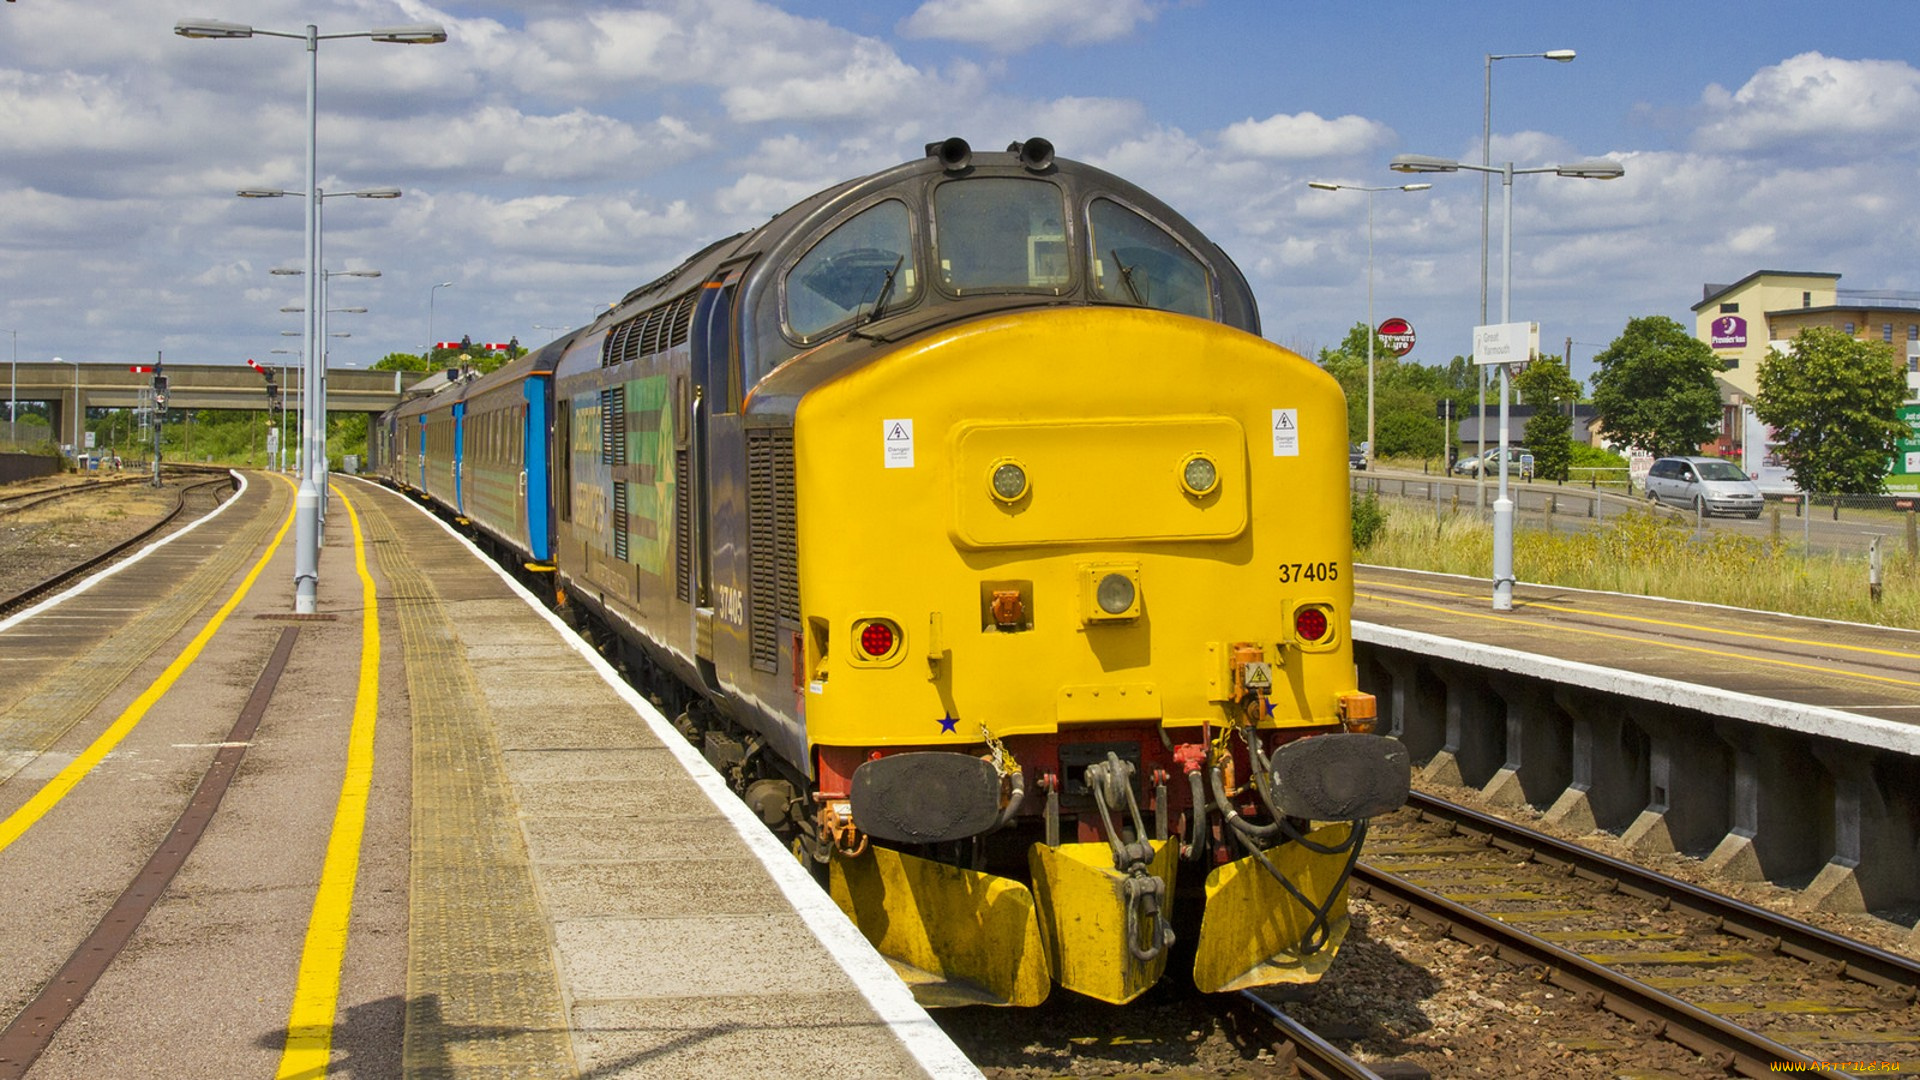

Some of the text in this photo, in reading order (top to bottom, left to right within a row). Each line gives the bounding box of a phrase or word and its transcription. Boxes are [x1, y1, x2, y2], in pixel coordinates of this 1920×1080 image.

[1483, 332, 1499, 343] Great
[1279, 562, 1338, 583] 37405
[719, 585, 743, 626] 37405
